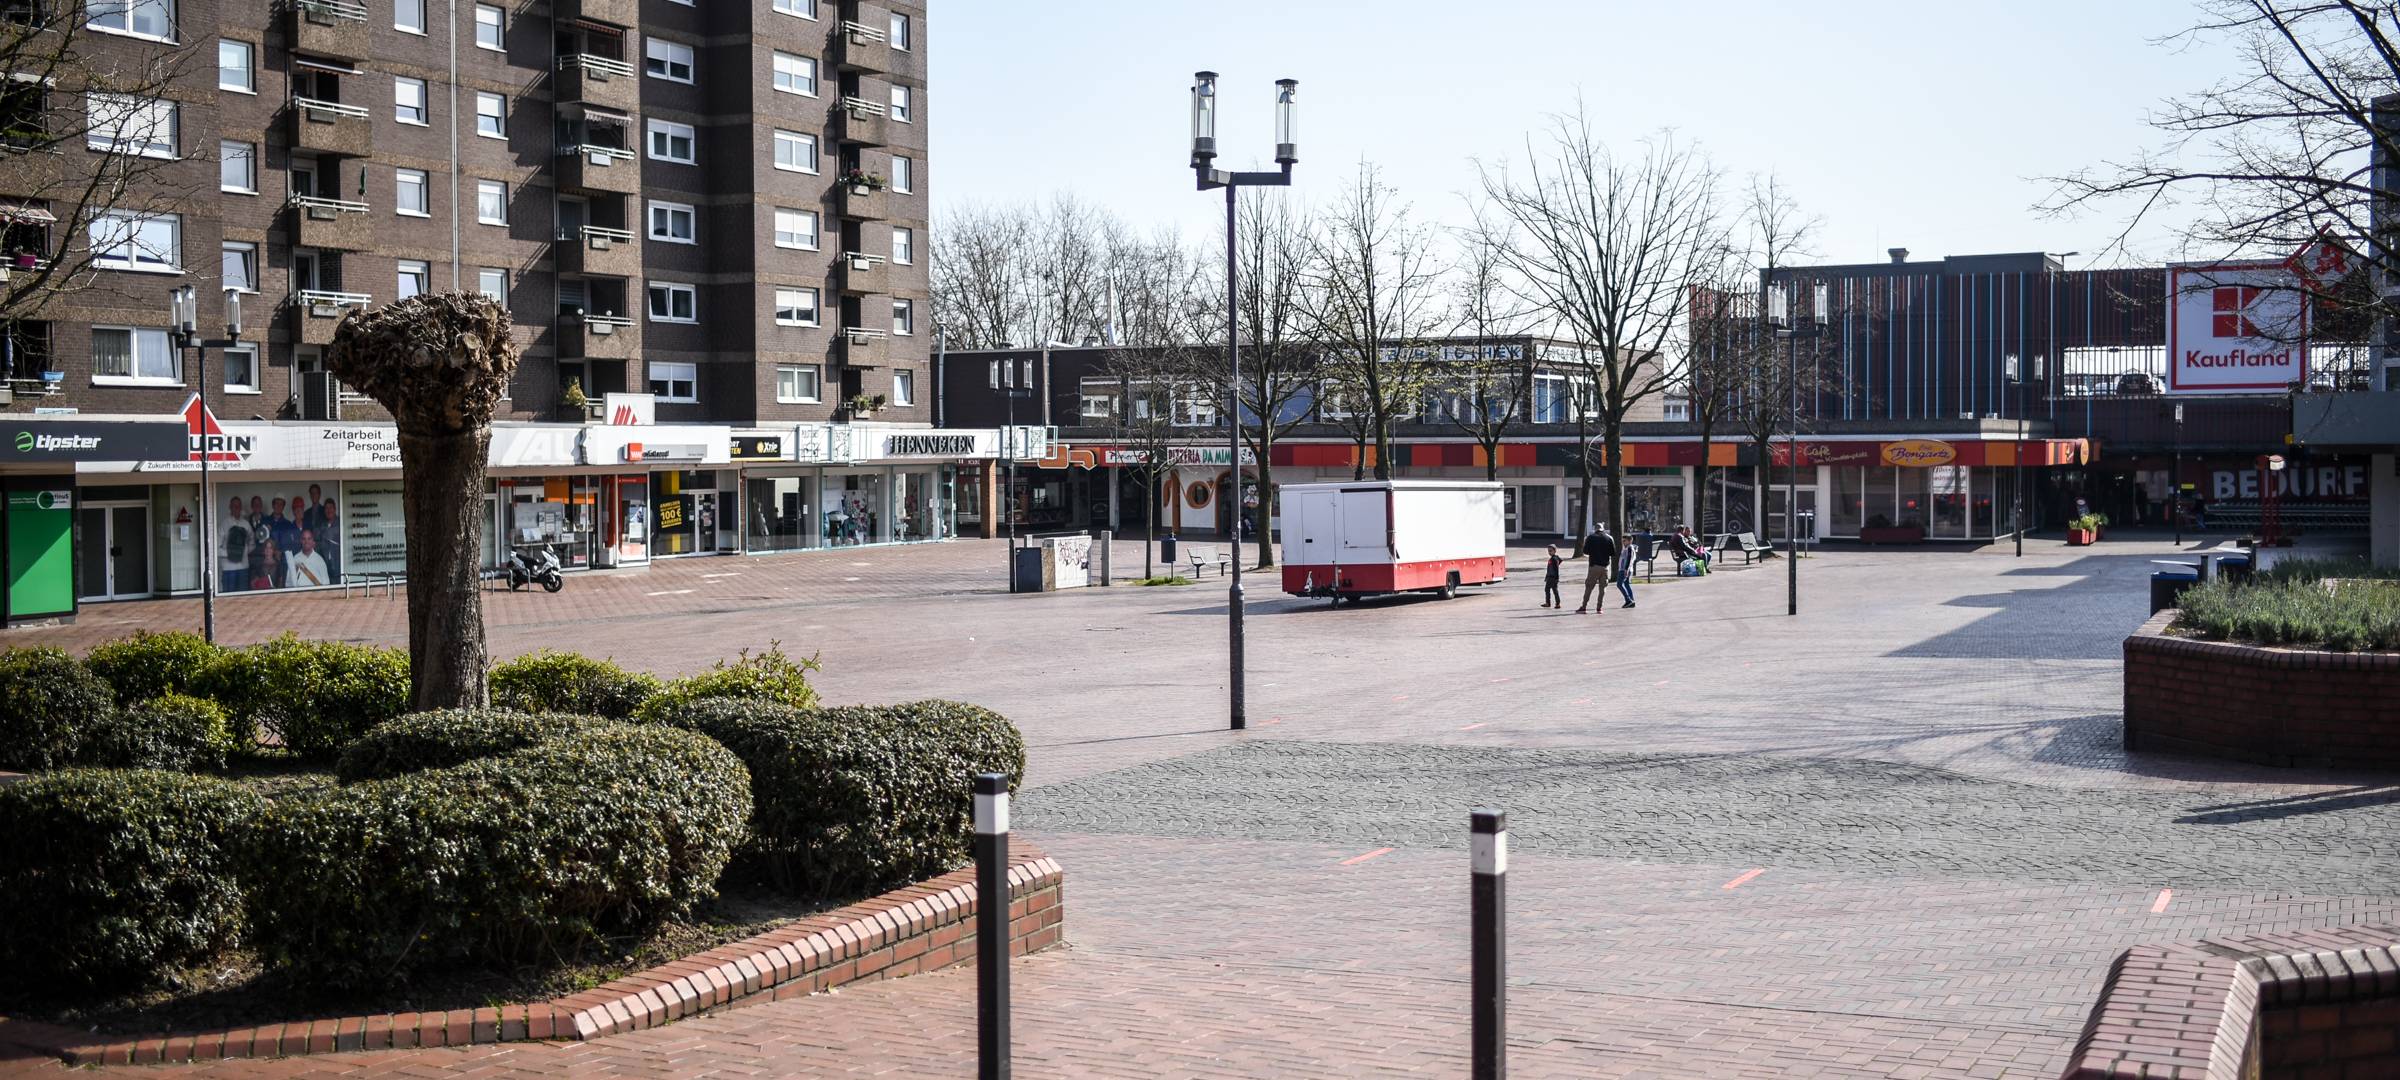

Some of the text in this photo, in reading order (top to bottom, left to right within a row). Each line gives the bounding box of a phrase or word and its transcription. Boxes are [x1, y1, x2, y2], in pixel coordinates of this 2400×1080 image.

[2186, 350, 2290, 369] Kaufland
[36, 434, 102, 451] tipster
[323, 430, 382, 440] Zeitarbeit
[888, 435, 976, 455] HENNEKEN
[1203, 448, 1213, 464] DA
[147, 462, 172, 470] Zukunft
[173, 462, 195, 470] sichern
[660, 509, 676, 520] 100
[676, 508, 682, 517] €
